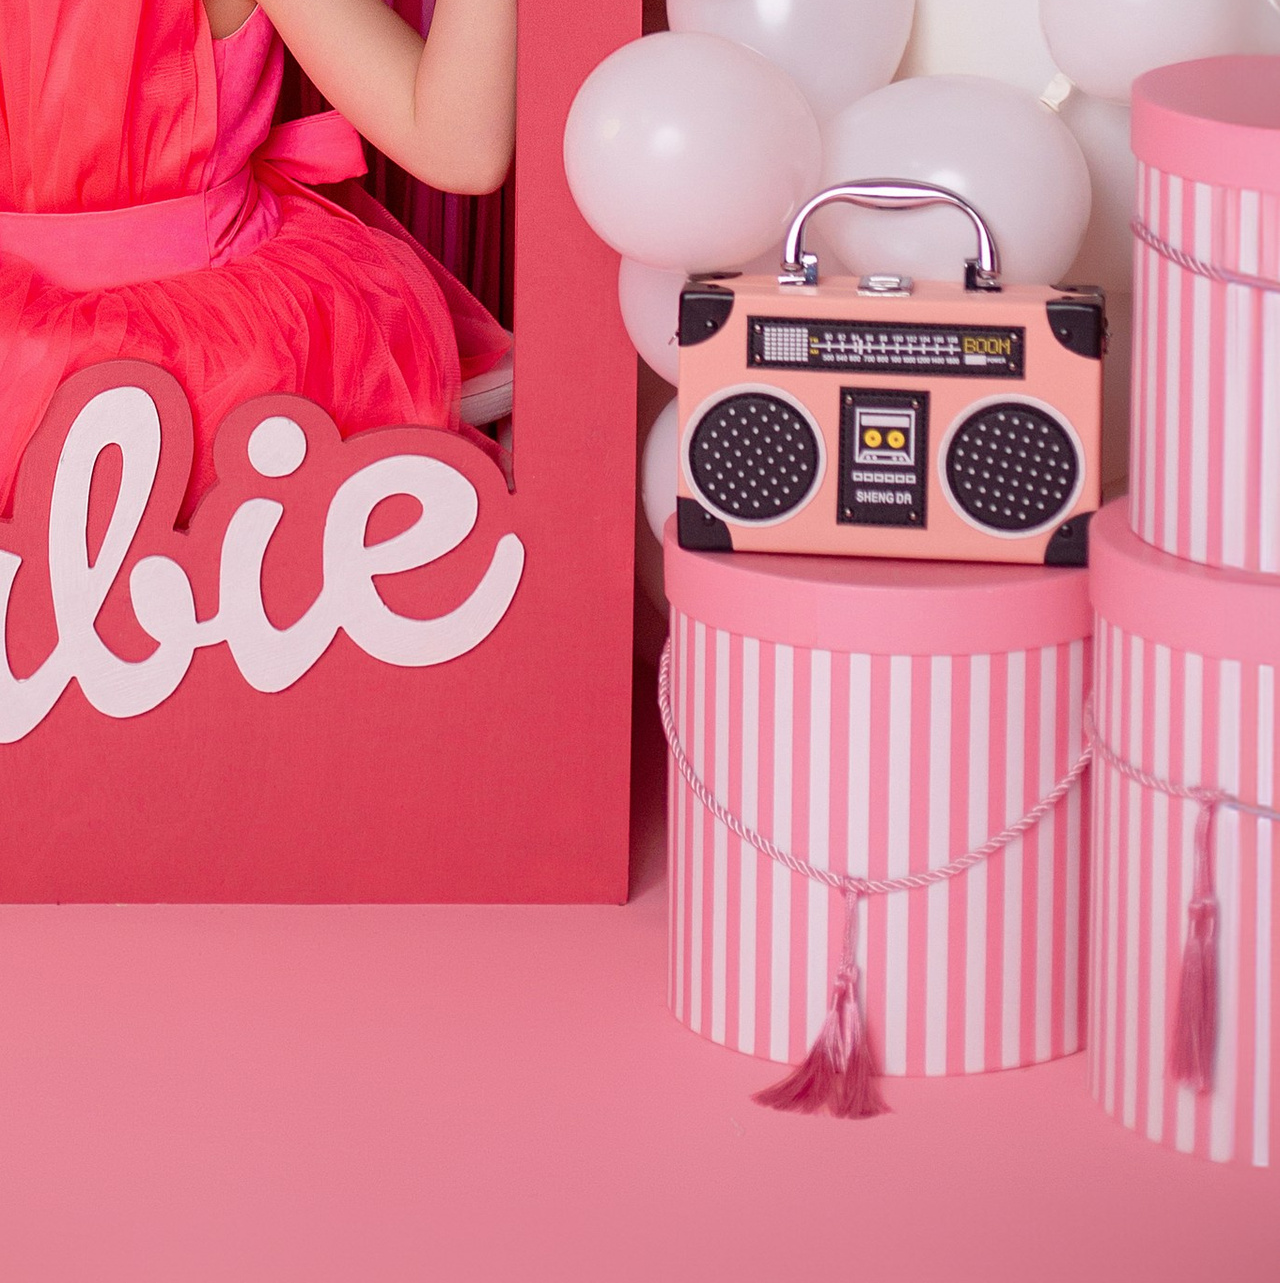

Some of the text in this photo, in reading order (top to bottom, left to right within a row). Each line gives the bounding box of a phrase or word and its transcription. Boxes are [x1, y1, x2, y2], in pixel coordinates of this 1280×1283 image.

[906, 334, 918, 344] 102
[919, 334, 931, 344] 104
[963, 336, 1011, 355] BOOM
[855, 489, 895, 504] SHENG
